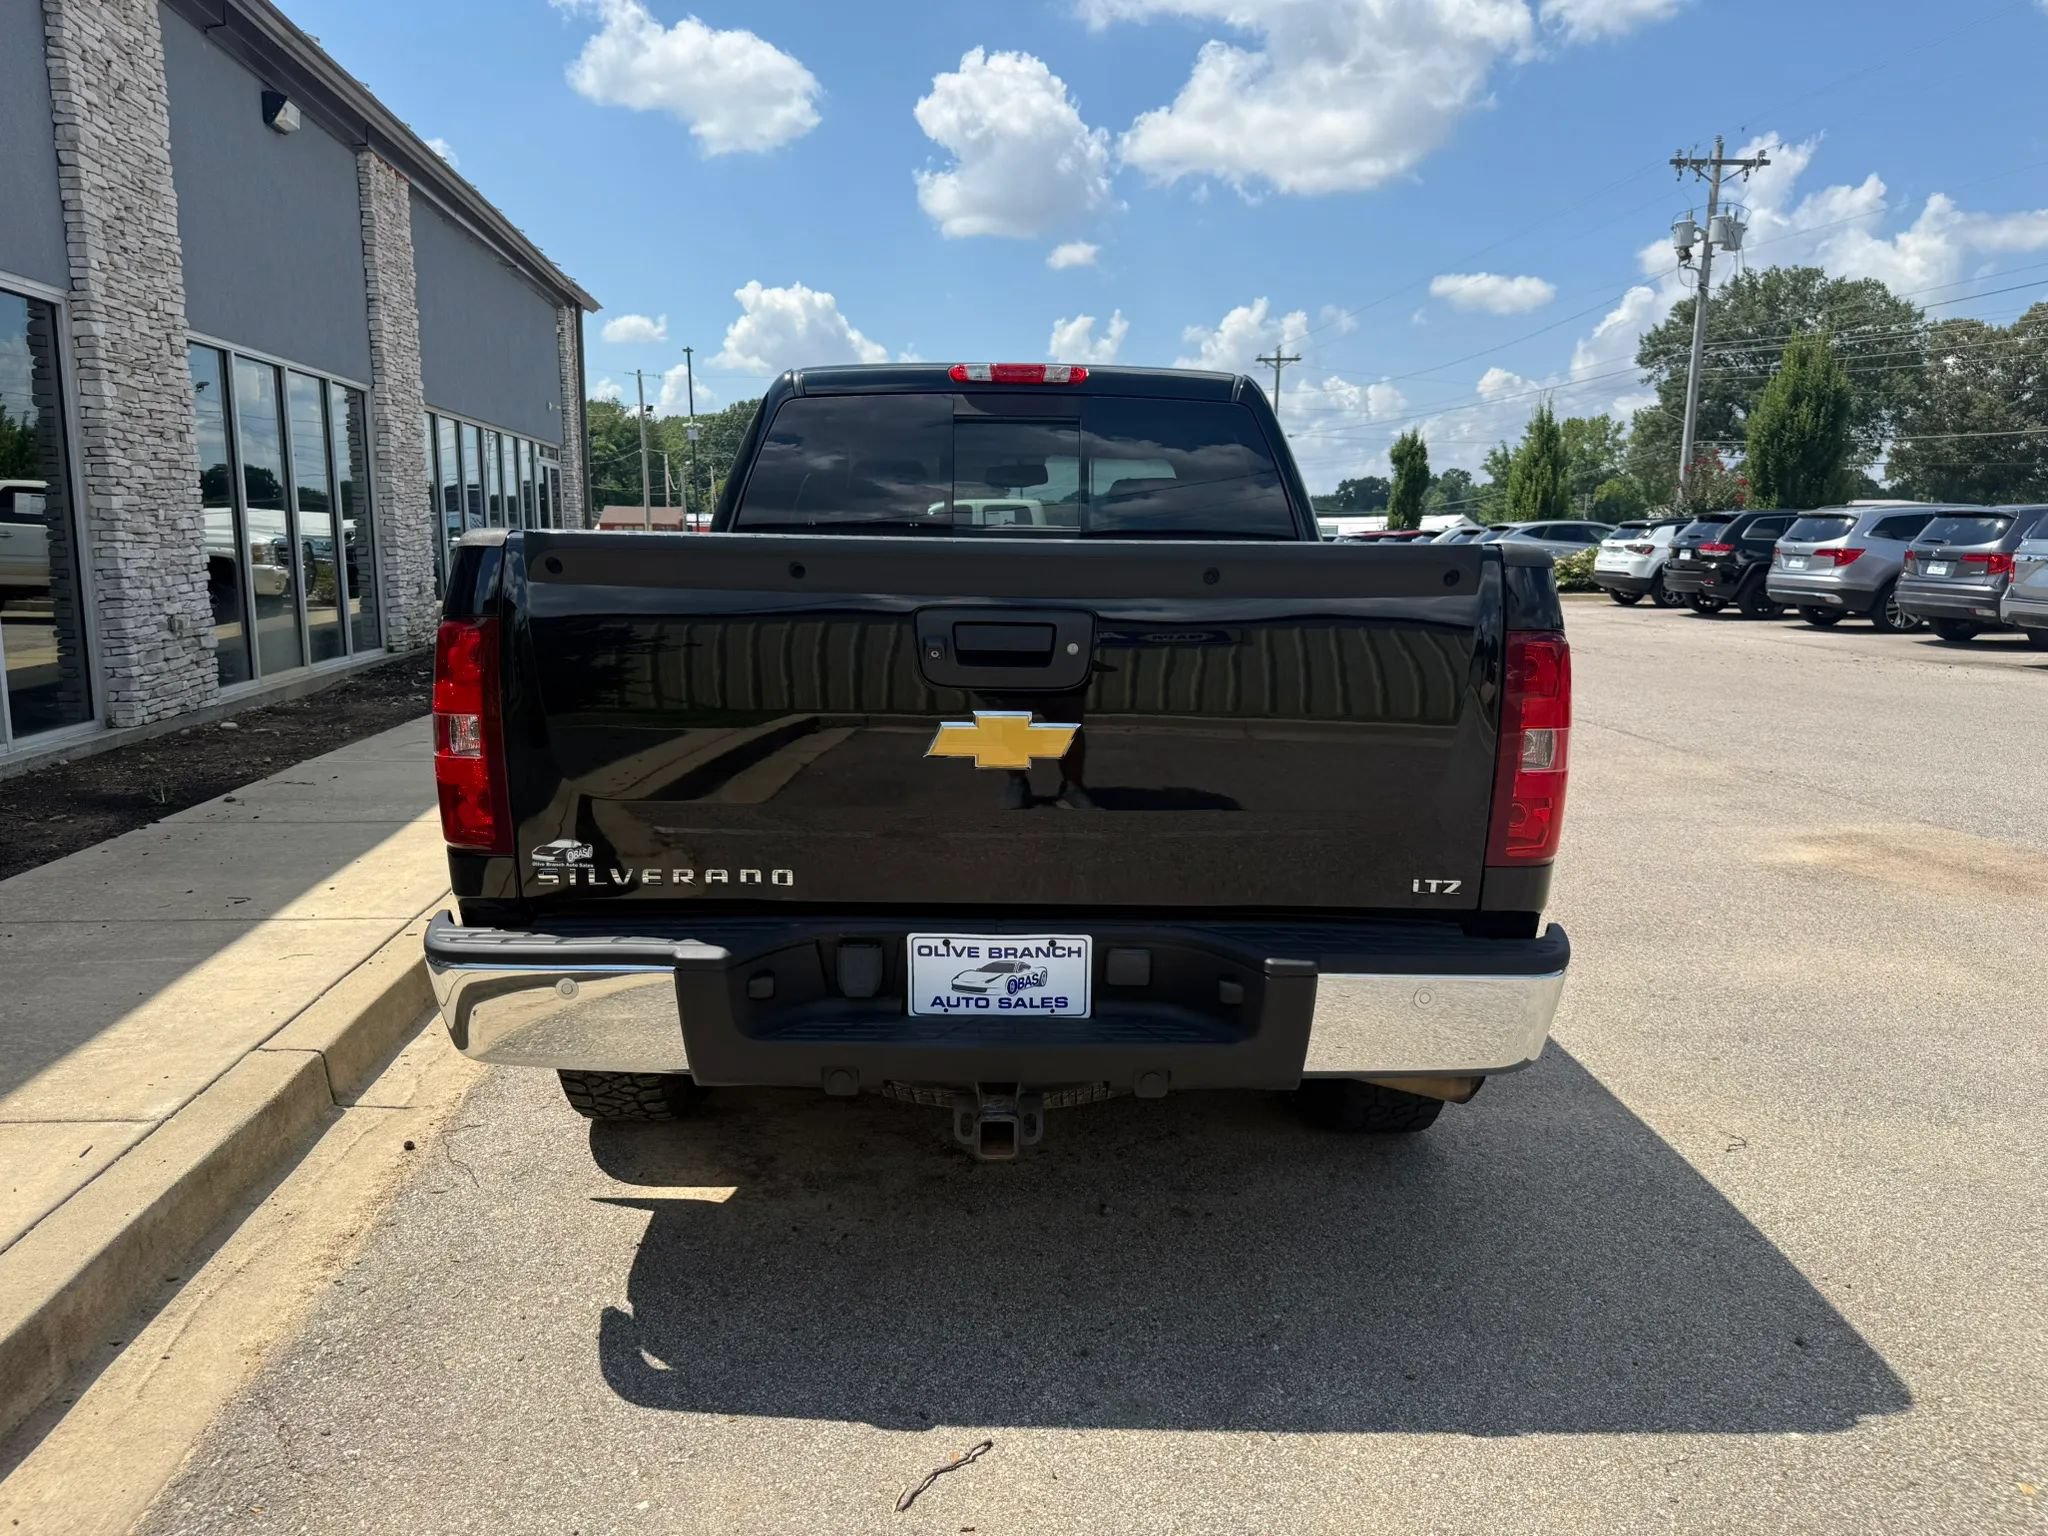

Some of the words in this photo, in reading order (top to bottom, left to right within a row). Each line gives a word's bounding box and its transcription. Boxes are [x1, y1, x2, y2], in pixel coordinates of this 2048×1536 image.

[537, 868, 794, 887] SILVERADO
[1412, 879, 1462, 895] LTZ
[917, 944, 980, 958] OLIVE
[988, 946, 1082, 959] BRANCH
[930, 995, 990, 1009] AUTO
[998, 996, 1069, 1009] SALES
